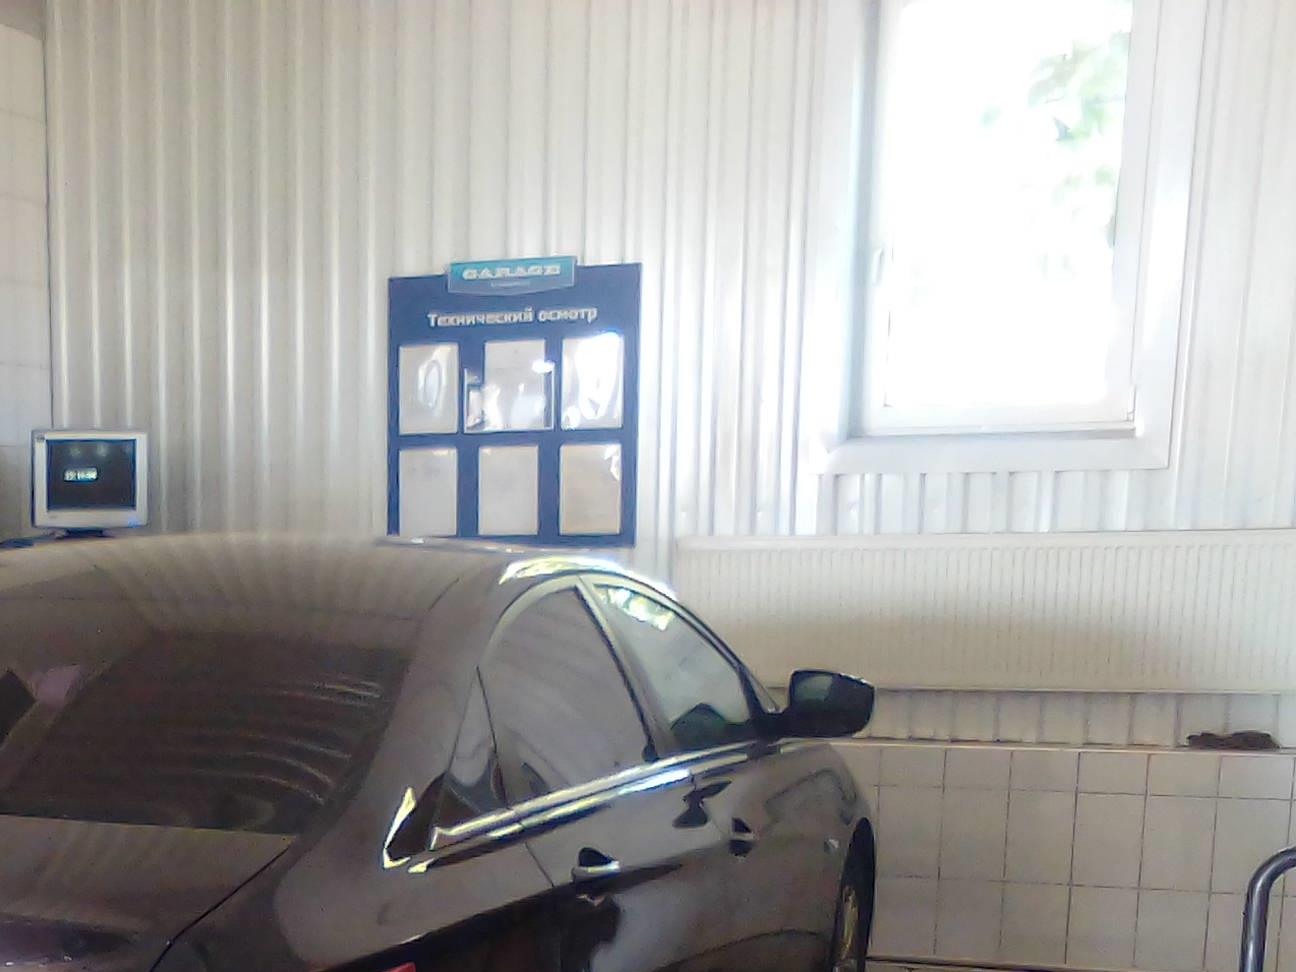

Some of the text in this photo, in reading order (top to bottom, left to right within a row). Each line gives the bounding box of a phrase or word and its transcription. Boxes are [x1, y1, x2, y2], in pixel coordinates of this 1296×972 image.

[462, 263, 561, 281] GARAGE
[428, 307, 597, 327] Технический осмотр
